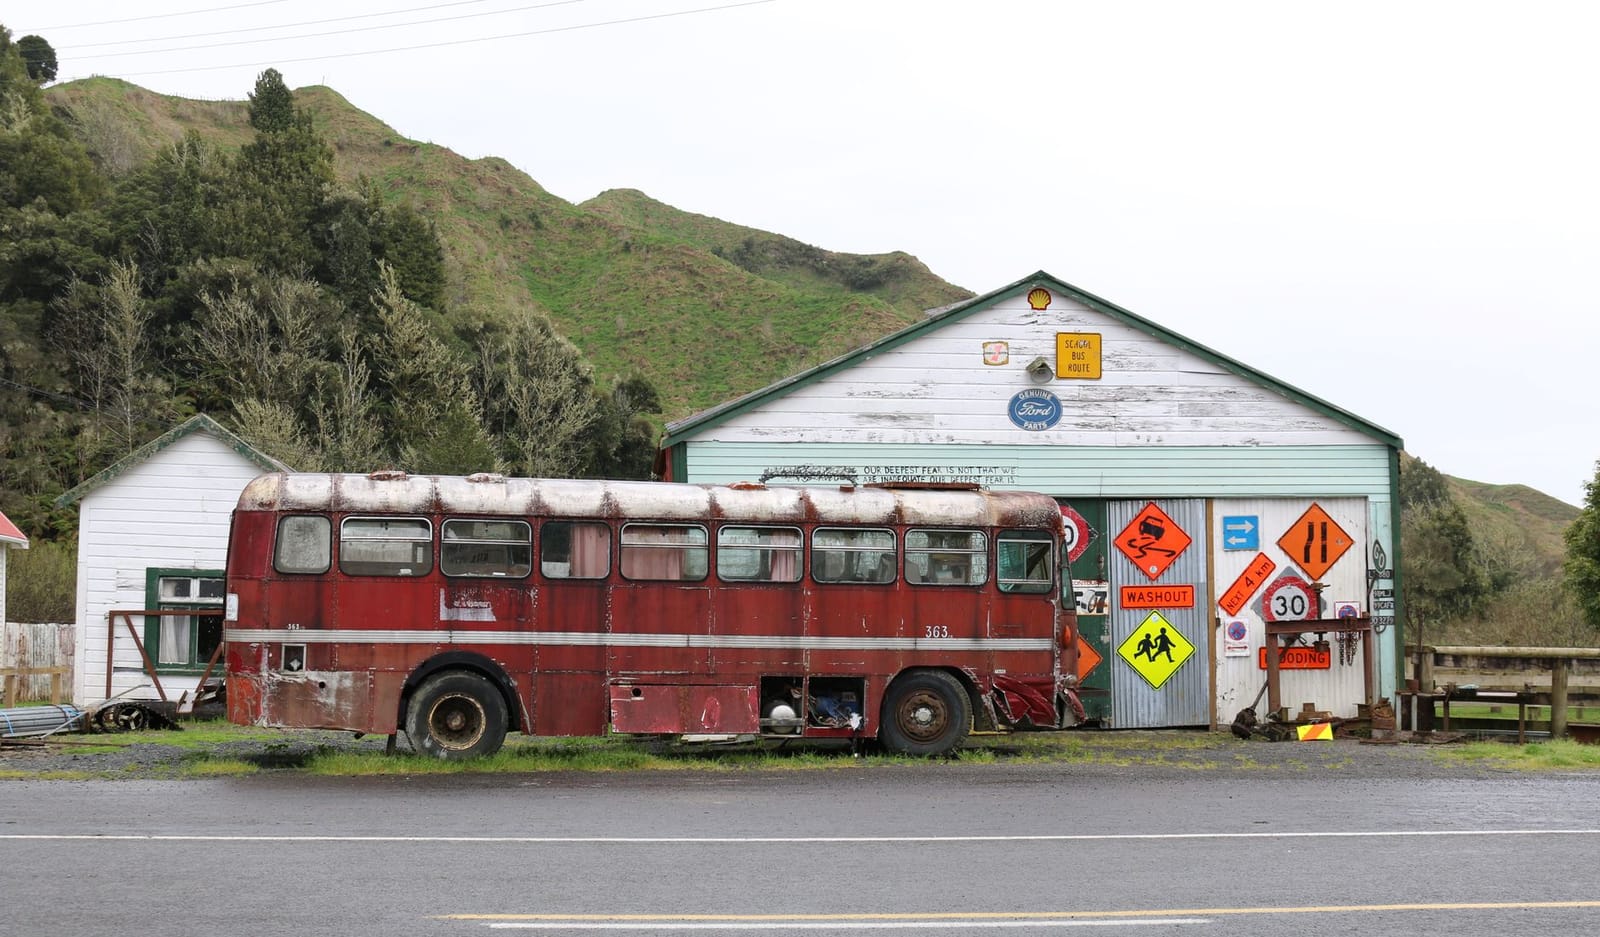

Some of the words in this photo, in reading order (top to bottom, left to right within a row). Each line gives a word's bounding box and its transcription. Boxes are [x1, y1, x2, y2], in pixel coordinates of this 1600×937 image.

[1072, 351, 1086, 361] BUS
[1068, 363, 1091, 373] ROUTE
[1018, 389, 1052, 400] GENUINE
[1017, 401, 1053, 416] Ford
[1023, 421, 1048, 430] PARTS
[864, 466, 881, 474] OUR
[884, 466, 918, 474] DEEPEST
[922, 466, 943, 474] FEAR
[946, 466, 954, 474] IS
[958, 466, 975, 474] NOT
[976, 466, 999, 474] THAT
[1001, 466, 1017, 474] WE
[863, 475, 877, 483] ARE
[930, 475, 946, 483] OUR
[985, 475, 1004, 484] FEAR
[1007, 475, 1015, 484] IS
[1226, 590, 1244, 610] NEXT
[1245, 576, 1255, 588] 4
[1256, 562, 1270, 577] km
[1127, 591, 1188, 603] WASHOUT
[1275, 595, 1305, 617] 30
[925, 625, 948, 638] 363
